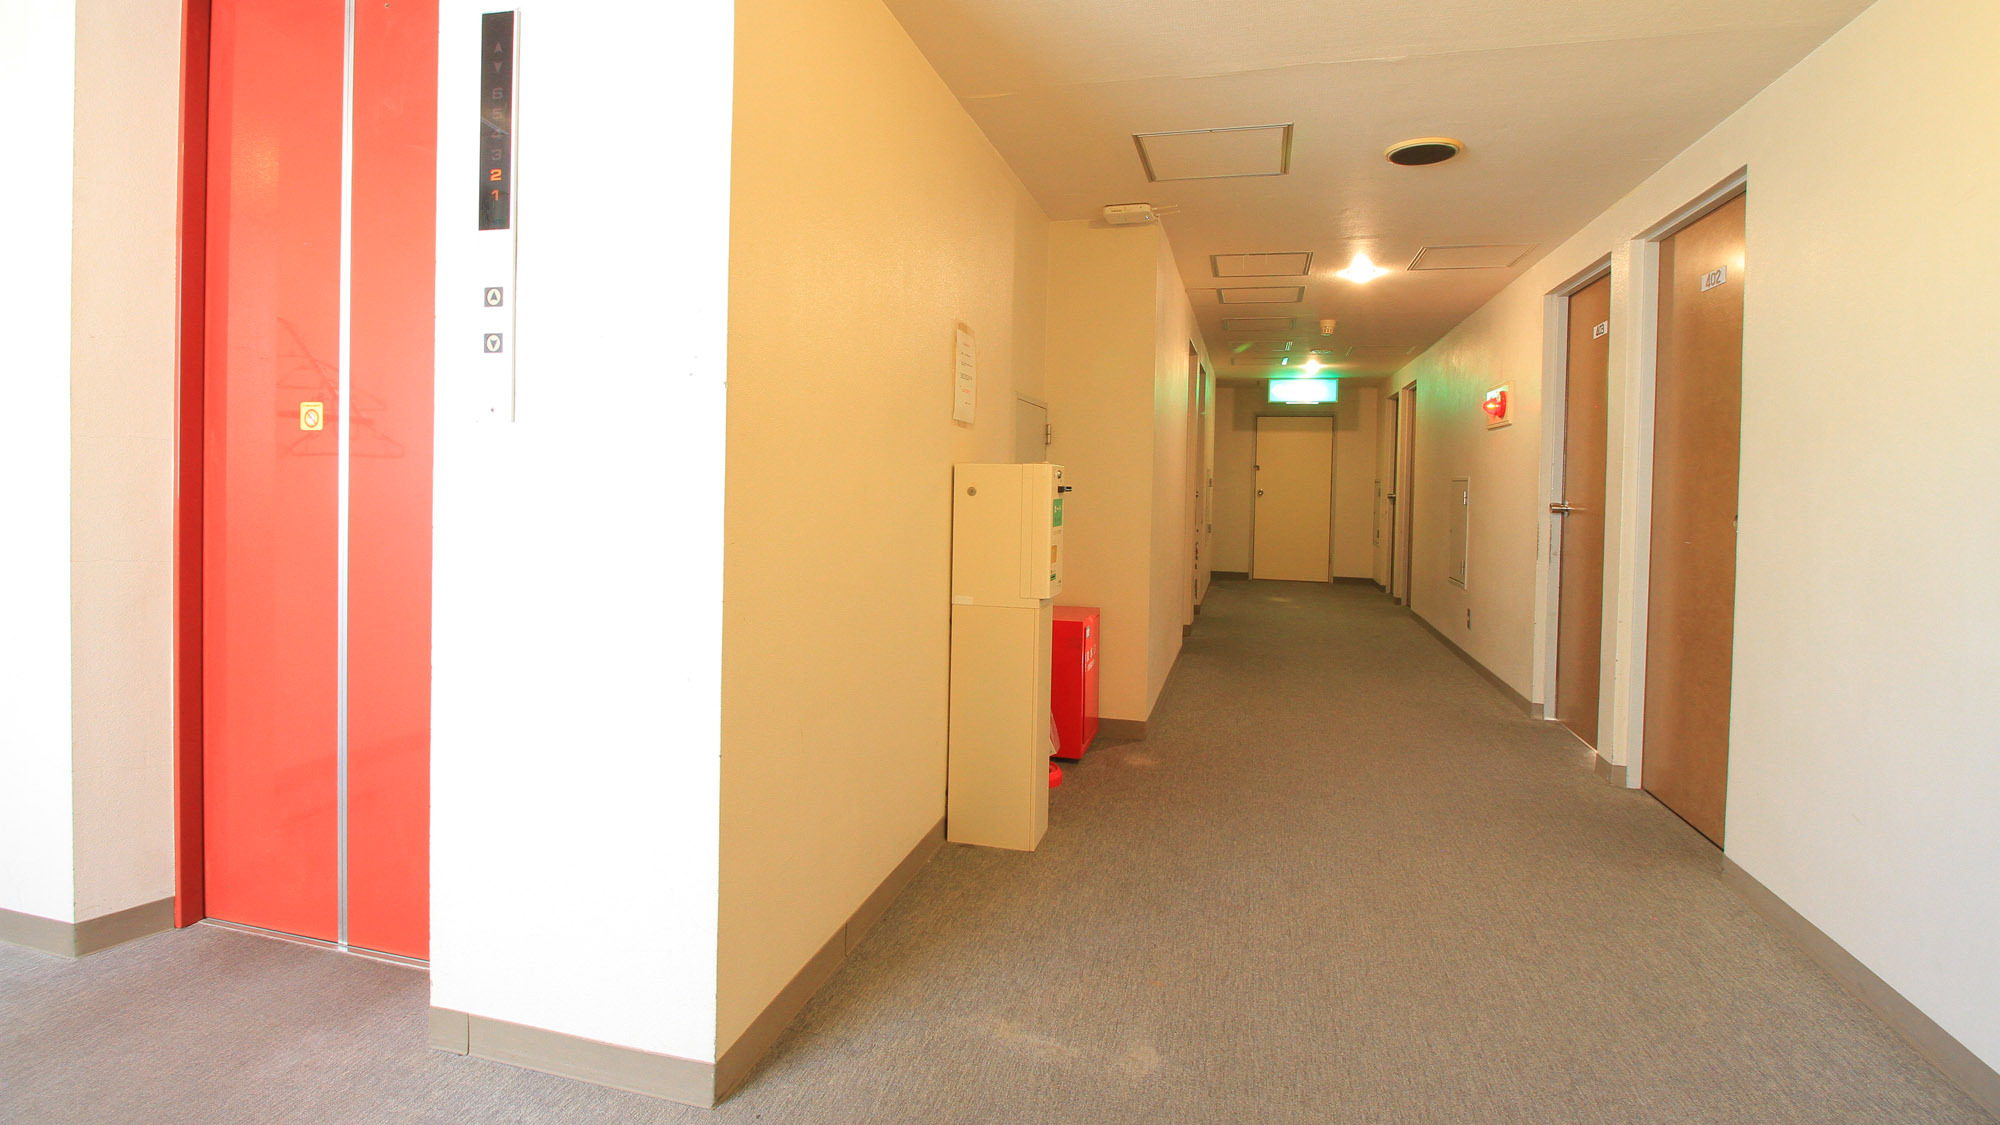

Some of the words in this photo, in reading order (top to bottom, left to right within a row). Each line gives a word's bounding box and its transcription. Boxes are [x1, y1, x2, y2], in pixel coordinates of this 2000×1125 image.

[490, 168, 502, 181] 2
[490, 189, 499, 201] 1
[1705, 269, 1721, 288] 402
